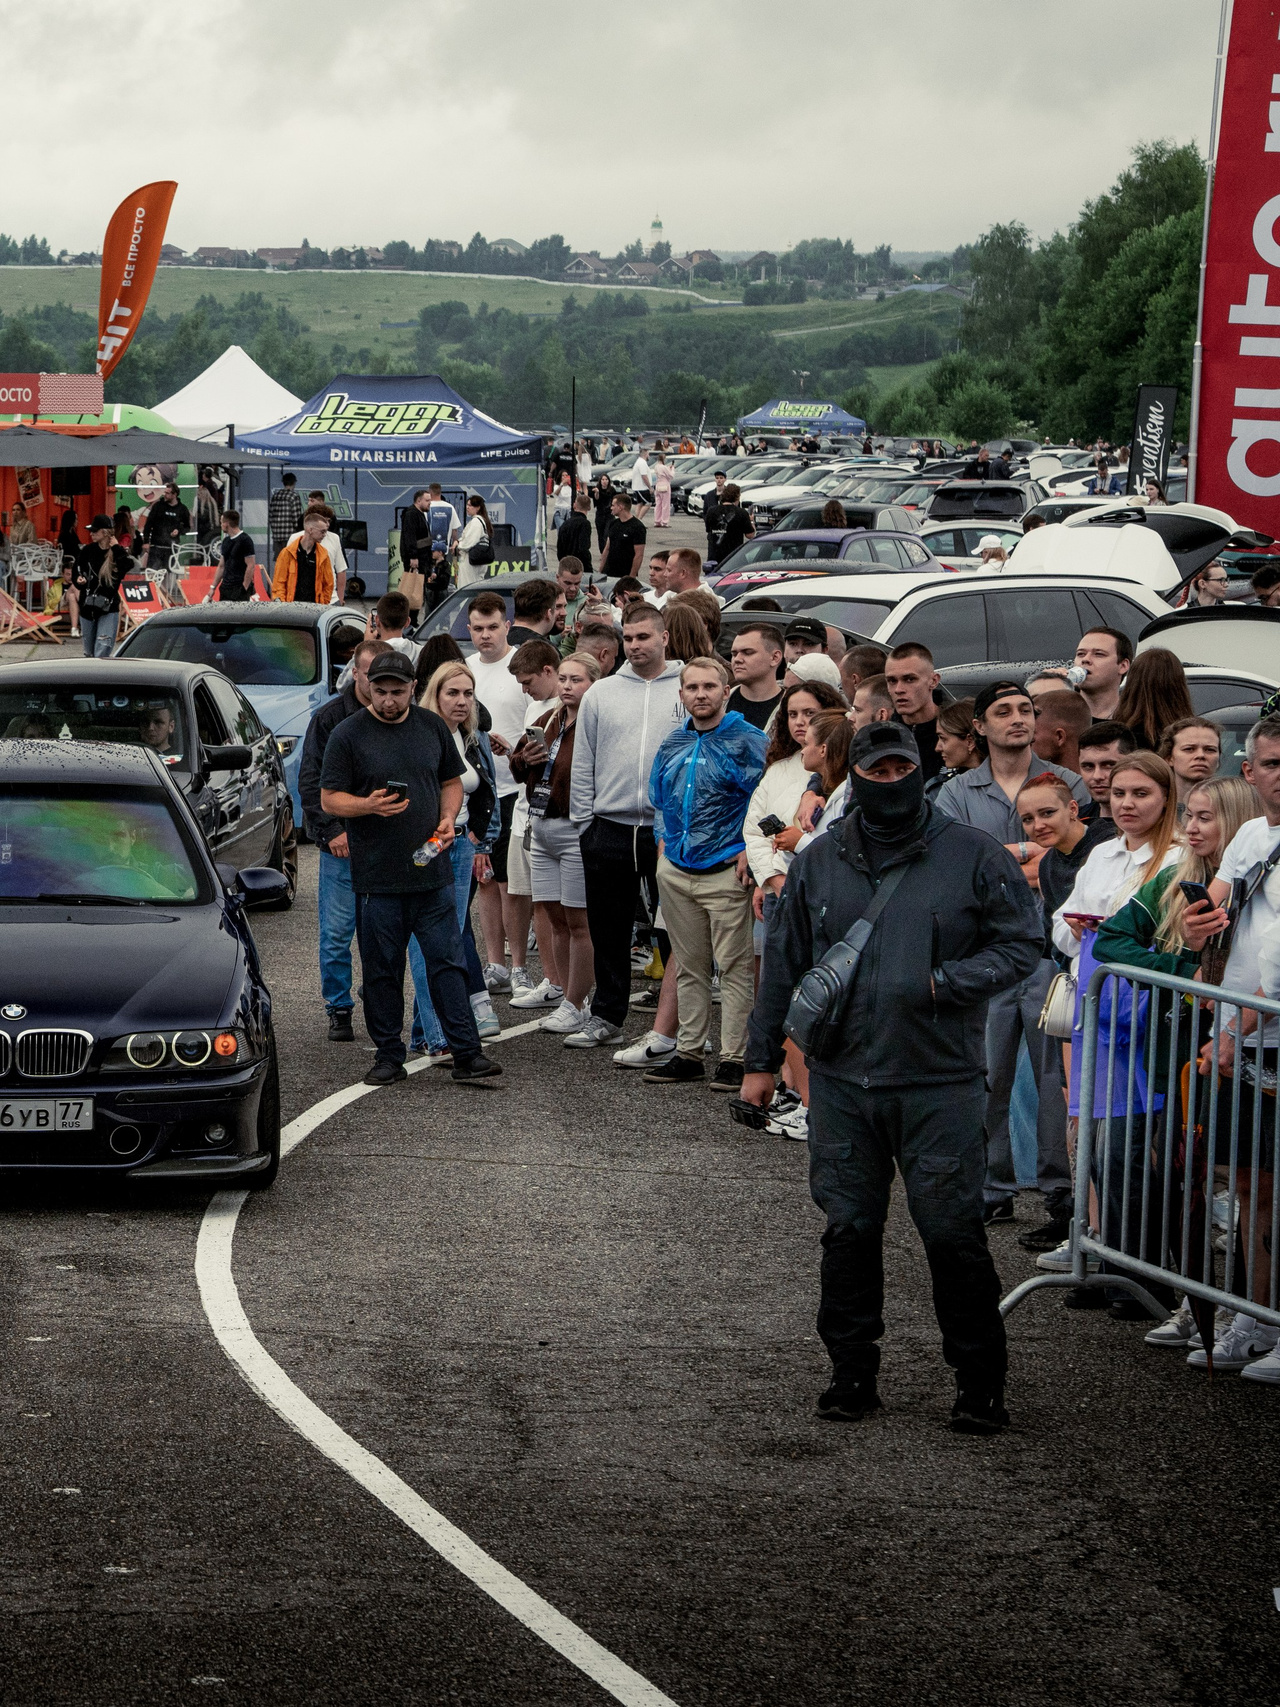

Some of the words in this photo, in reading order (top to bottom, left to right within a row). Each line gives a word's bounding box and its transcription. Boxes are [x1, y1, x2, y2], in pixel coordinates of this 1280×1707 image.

[127, 207, 146, 262] ПРОСТО
[264, 448, 290, 457] pulse
[330, 448, 438, 463] DIKARSHINA
[480, 450, 502, 458] LIFE
[504, 448, 530, 458] pulse
[487, 560, 531, 578] TAXI
[59, 1102, 84, 1120] 77
